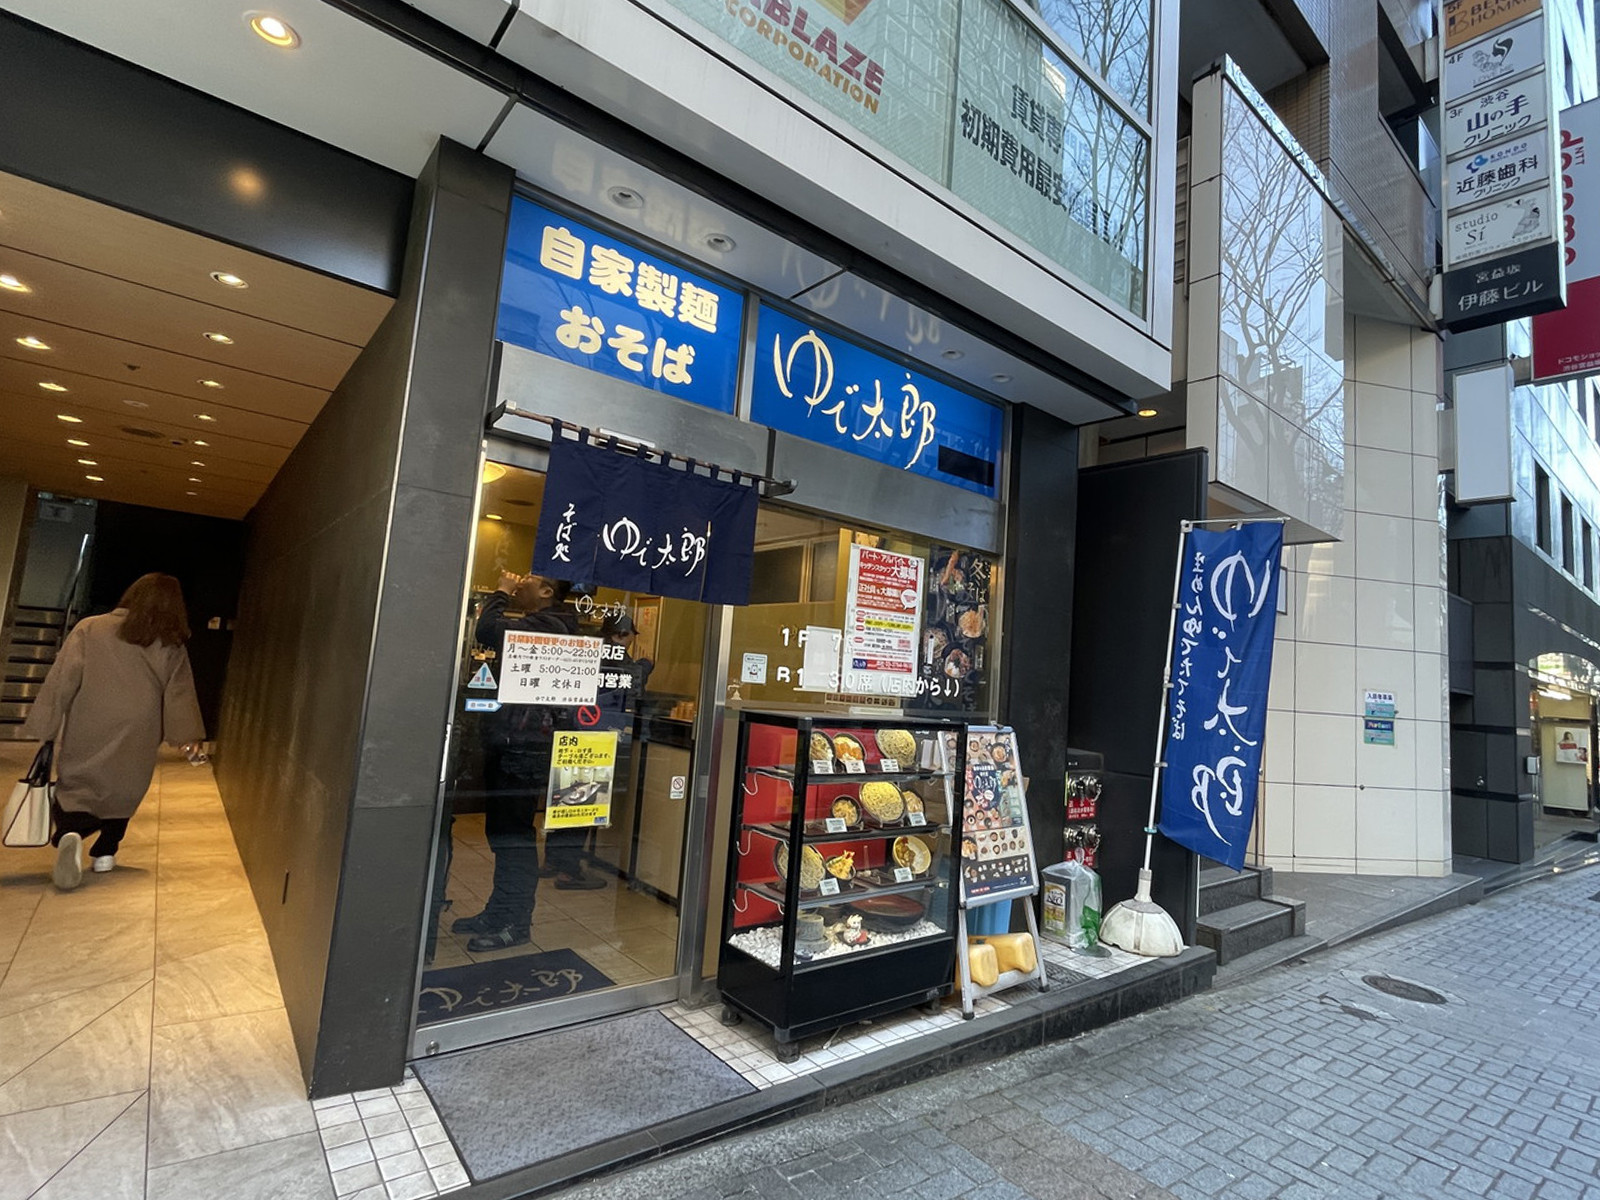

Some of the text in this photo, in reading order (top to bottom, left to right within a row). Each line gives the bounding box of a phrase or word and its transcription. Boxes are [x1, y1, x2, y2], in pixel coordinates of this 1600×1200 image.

[724, 0, 880, 114] CORPORATION
[1449, 53, 1464, 64] 4F
[1450, 108, 1463, 119] 3F
[1467, 94, 1530, 133] 山の手
[1480, 88, 1509, 108] 渋谷
[1464, 114, 1532, 149] クリニック
[1456, 155, 1538, 195] 近藤歯科
[1473, 177, 1521, 198] クリニック
[1455, 212, 1498, 233] studio
[540, 225, 719, 333] 自家製麺
[1458, 279, 1544, 311] 伊藤ビル
[556, 306, 696, 385] おそば
[773, 329, 936, 470] ゆで太郎
[602, 517, 706, 577] ゆで太郎
[519, 677, 582, 690] 日曜 定休日
